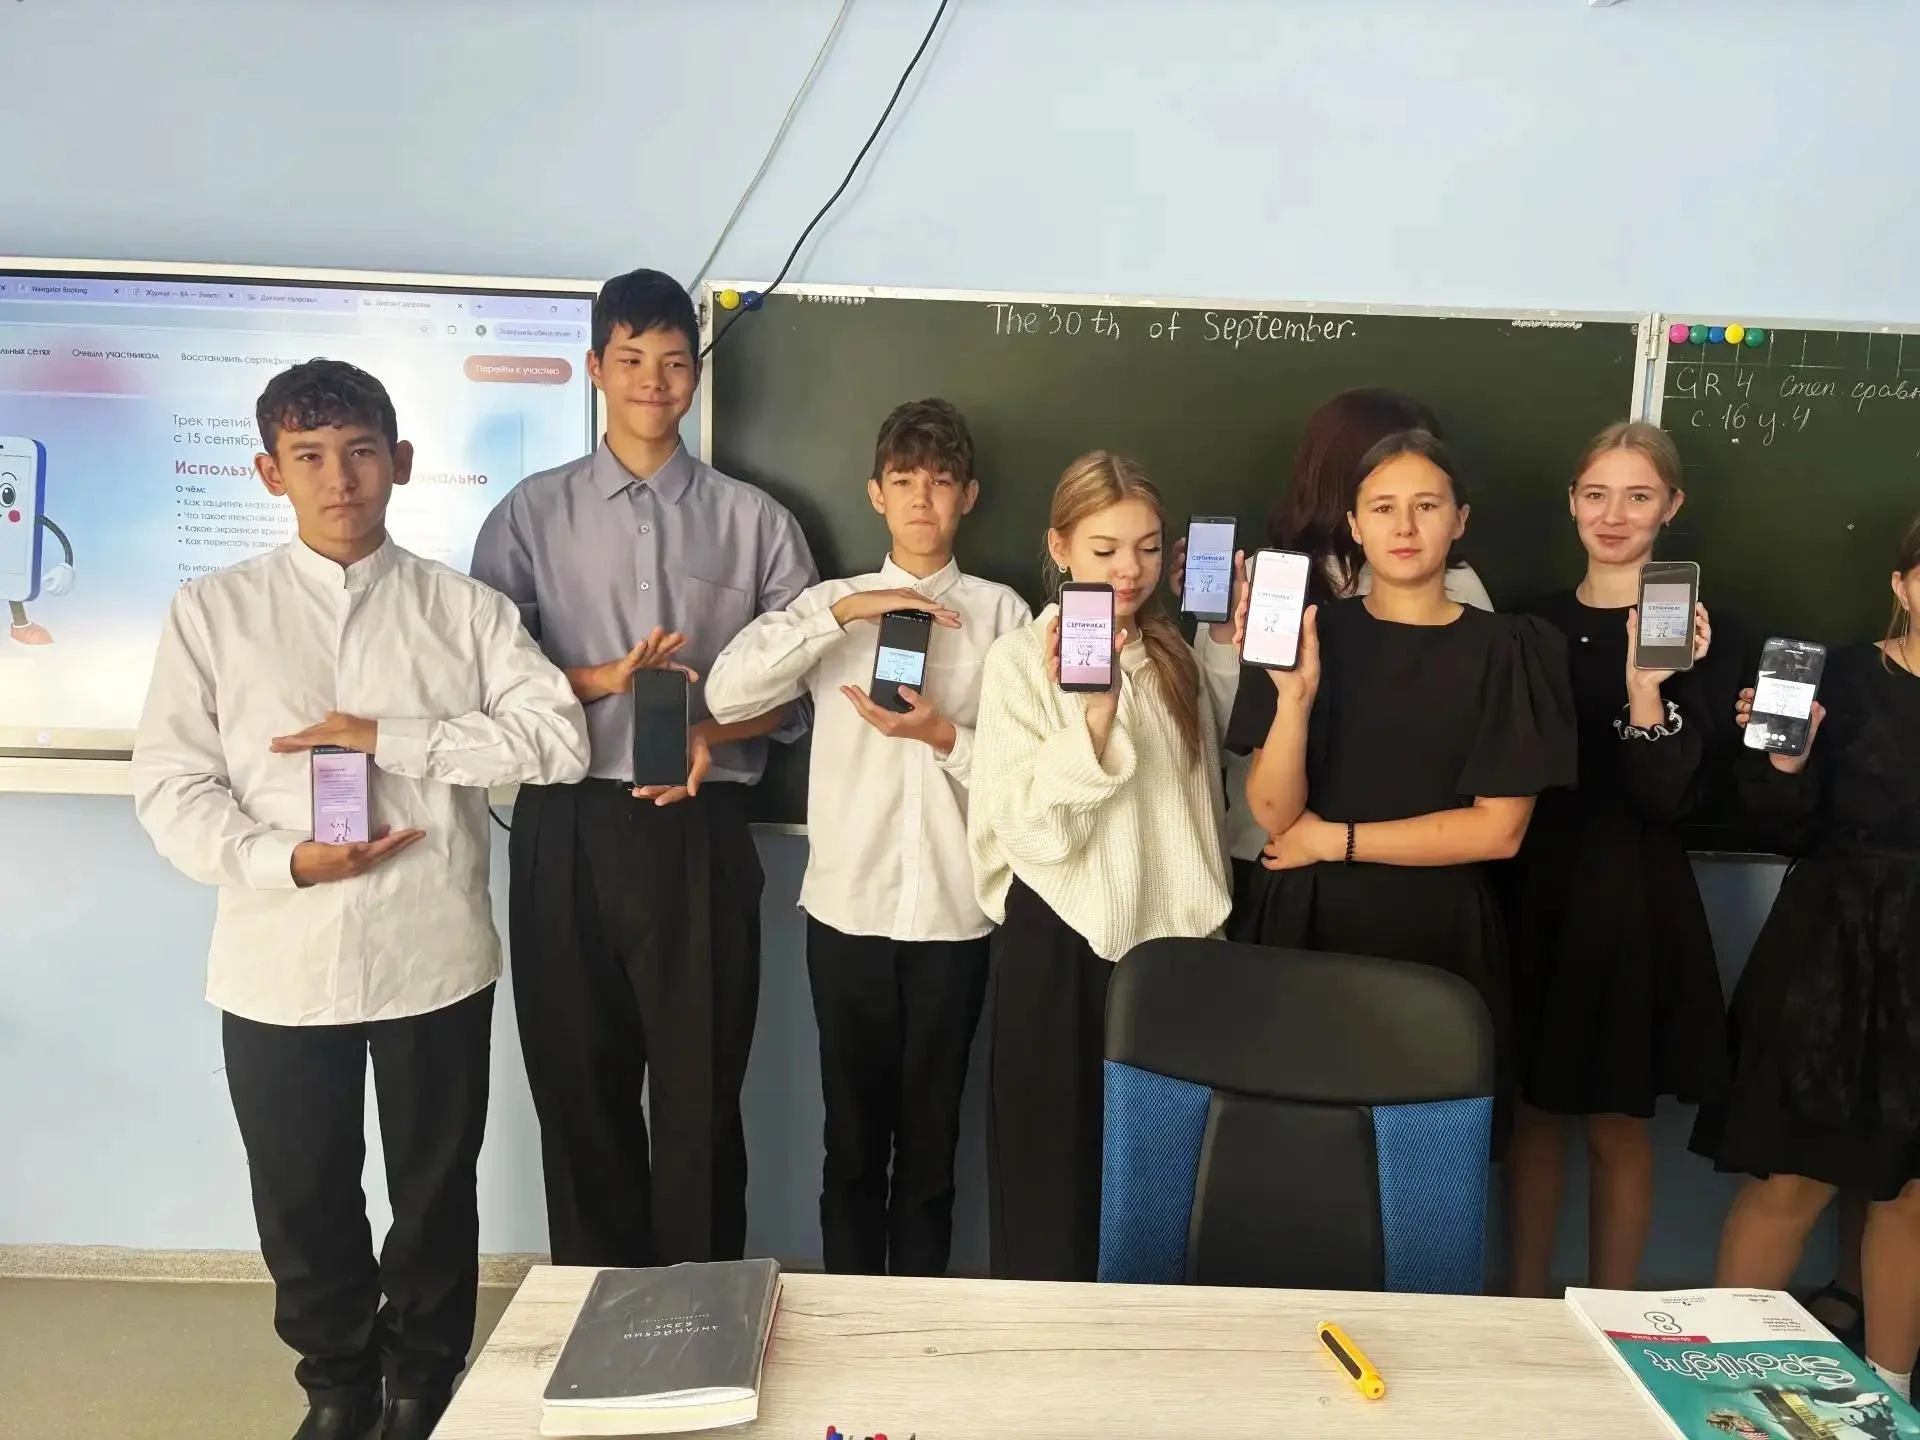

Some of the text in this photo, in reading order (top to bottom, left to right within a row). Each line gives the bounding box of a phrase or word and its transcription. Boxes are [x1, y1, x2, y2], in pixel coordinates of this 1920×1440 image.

[32, 285, 61, 294] Navigator
[987, 303, 1038, 335] The
[1150, 311, 1182, 342] of
[72, 348, 160, 360] Очным участникам
[181, 352, 242, 363] Восстановить
[475, 364, 514, 376] Перейти
[522, 367, 560, 377] участию
[173, 414, 252, 429] Трек третий
[173, 434, 182, 443] с
[187, 432, 201, 444] 15
[185, 485, 206, 494] чём:
[184, 499, 201, 507] Как
[202, 500, 244, 510] защитить
[184, 511, 199, 520] Что
[201, 512, 228, 521] такое
[185, 525, 213, 533] Какое
[214, 526, 260, 535] экранное
[185, 538, 202, 546] Как
[203, 538, 251, 548] перестать
[178, 563, 191, 572] По
[1066, 621, 1107, 629] СЕРТИФИКАТ
[1643, 1311, 1682, 1335] 8
[1643, 1349, 1856, 1387] Spotlight
